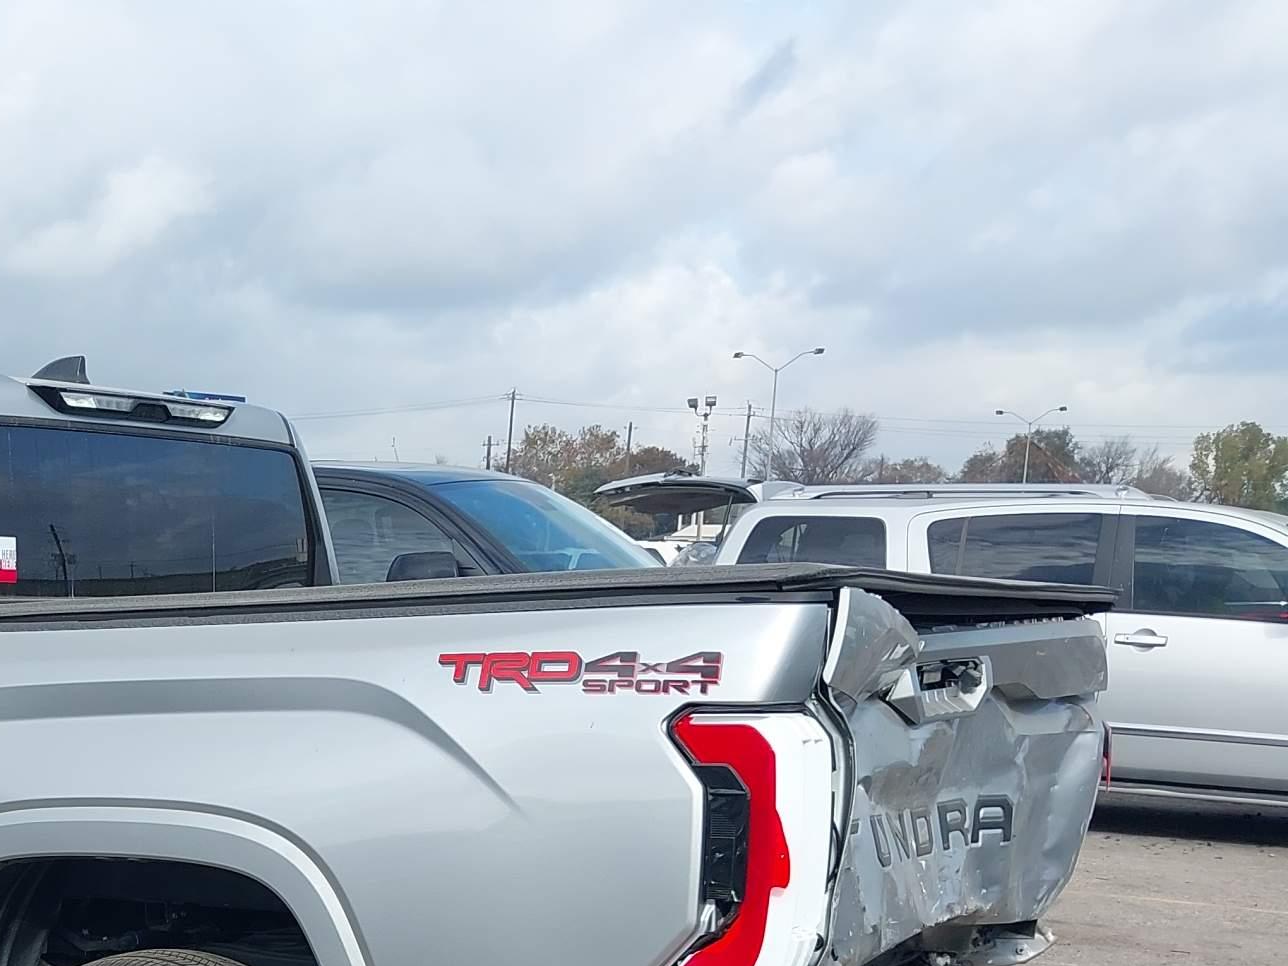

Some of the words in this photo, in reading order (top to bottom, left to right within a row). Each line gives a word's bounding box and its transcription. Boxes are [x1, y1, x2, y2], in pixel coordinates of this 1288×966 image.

[439, 651, 583, 693] TRD
[582, 679, 722, 695] SPORT
[850, 794, 1013, 868] UNDRA
